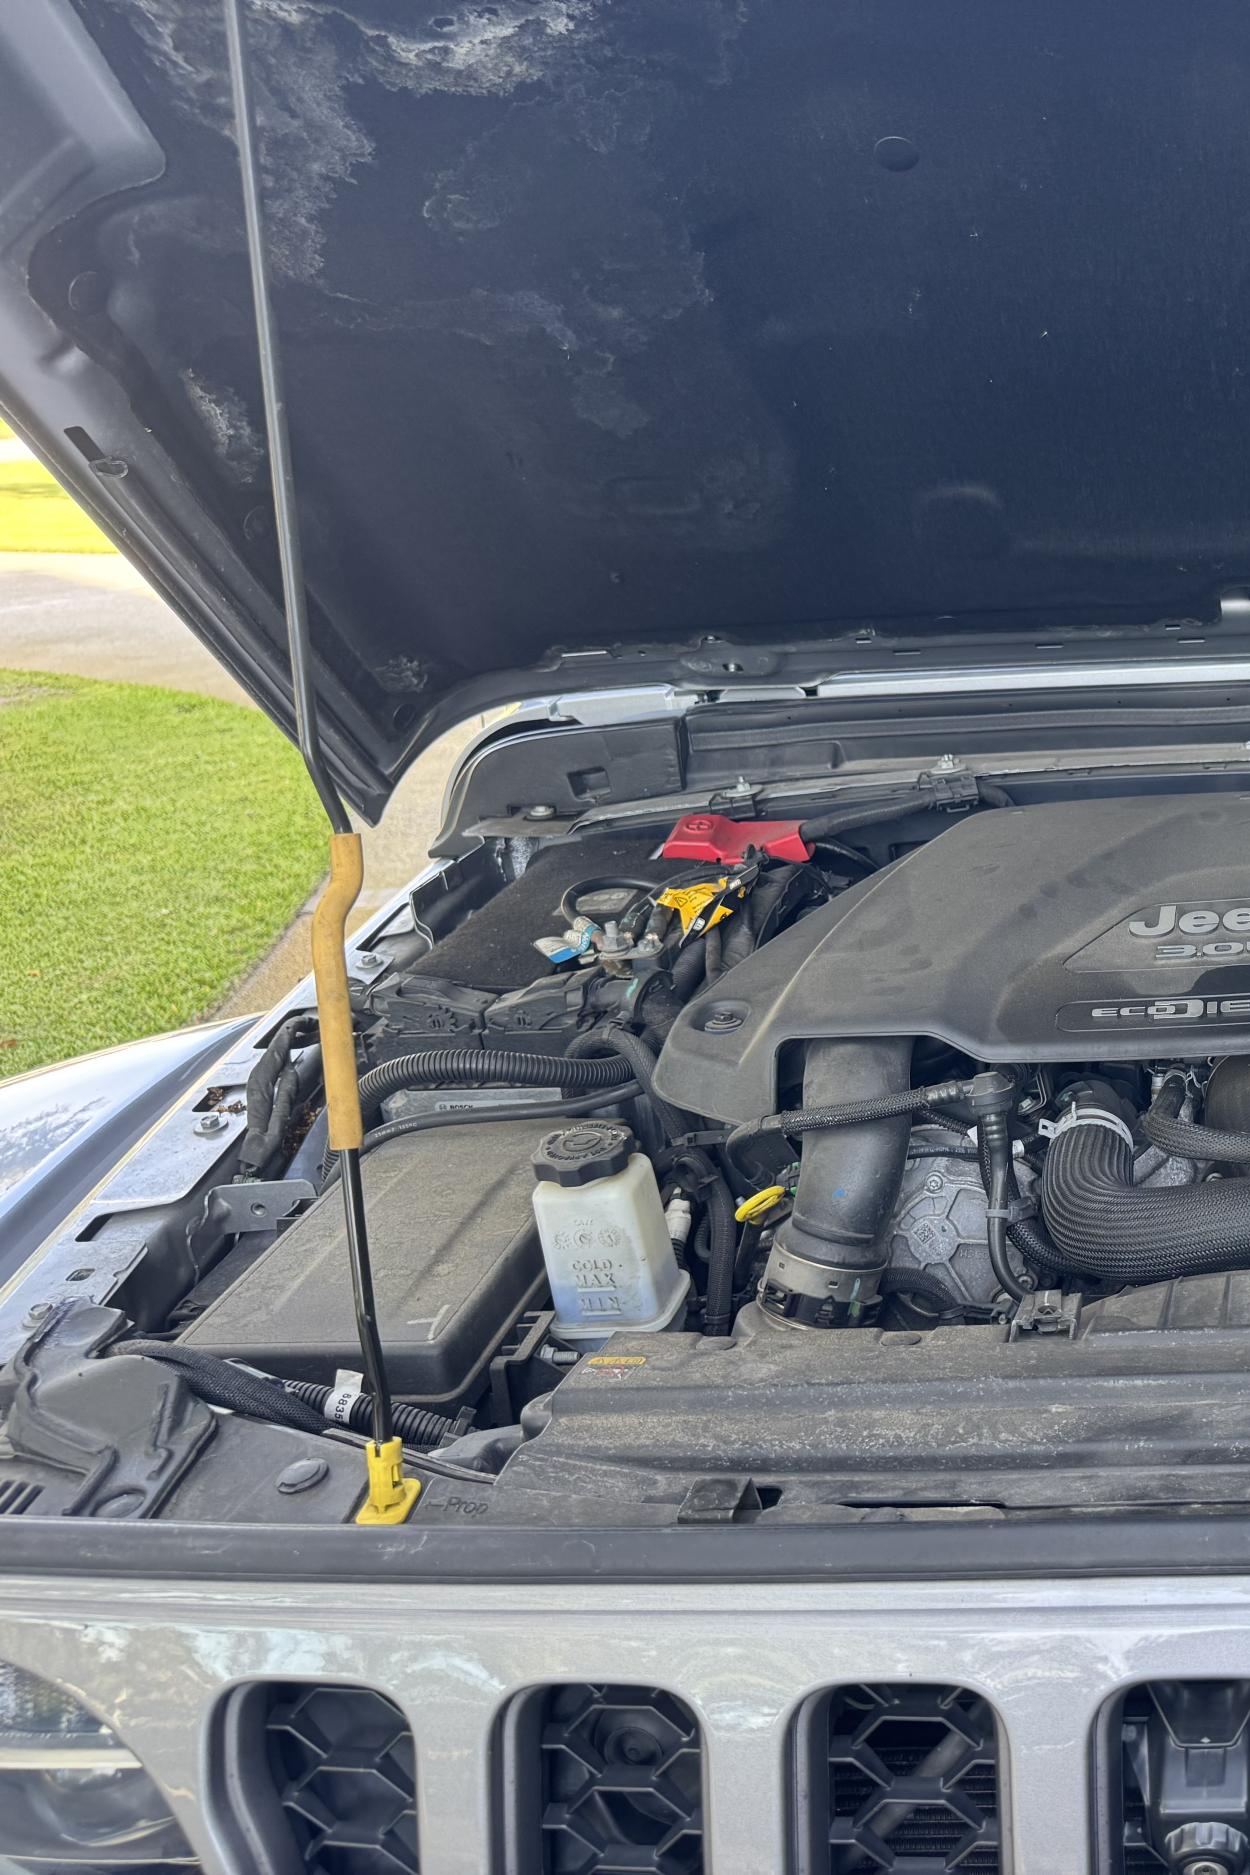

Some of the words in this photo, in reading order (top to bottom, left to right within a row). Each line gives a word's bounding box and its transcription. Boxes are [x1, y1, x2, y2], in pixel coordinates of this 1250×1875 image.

[571, 1258, 613, 1272] COLD
[575, 1273, 617, 1288] MAX
[442, 1496, 489, 1518] Prop
